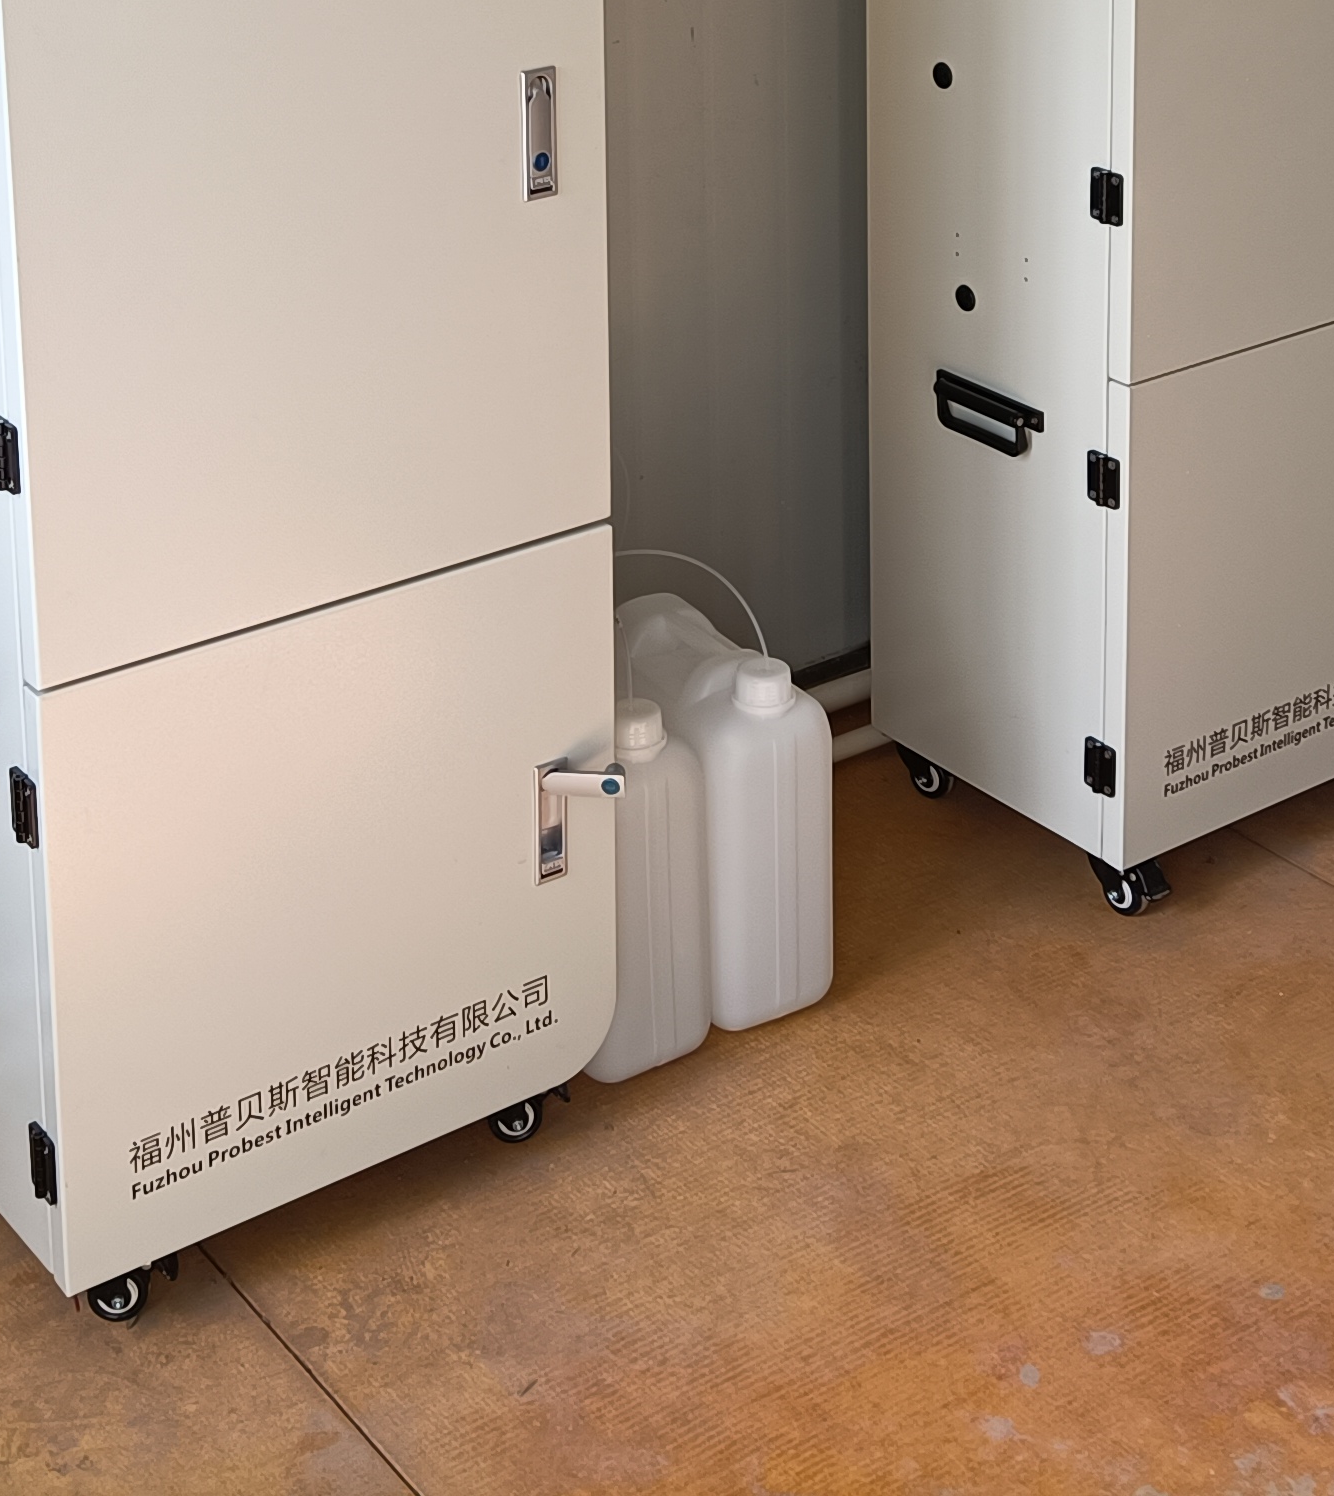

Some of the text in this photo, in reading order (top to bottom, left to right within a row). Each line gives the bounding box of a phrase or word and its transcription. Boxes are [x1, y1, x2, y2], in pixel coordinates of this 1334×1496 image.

[1164, 768, 1209, 798] Fuzhou
[1211, 748, 1258, 778] Probest
[1259, 722, 1321, 757] Intelligent
[128, 974, 550, 1174] 福州普贝斯智能科技有限公司
[131, 1009, 559, 1200] Fuzhou Probest Intelligent Technology Co., Ltd.
